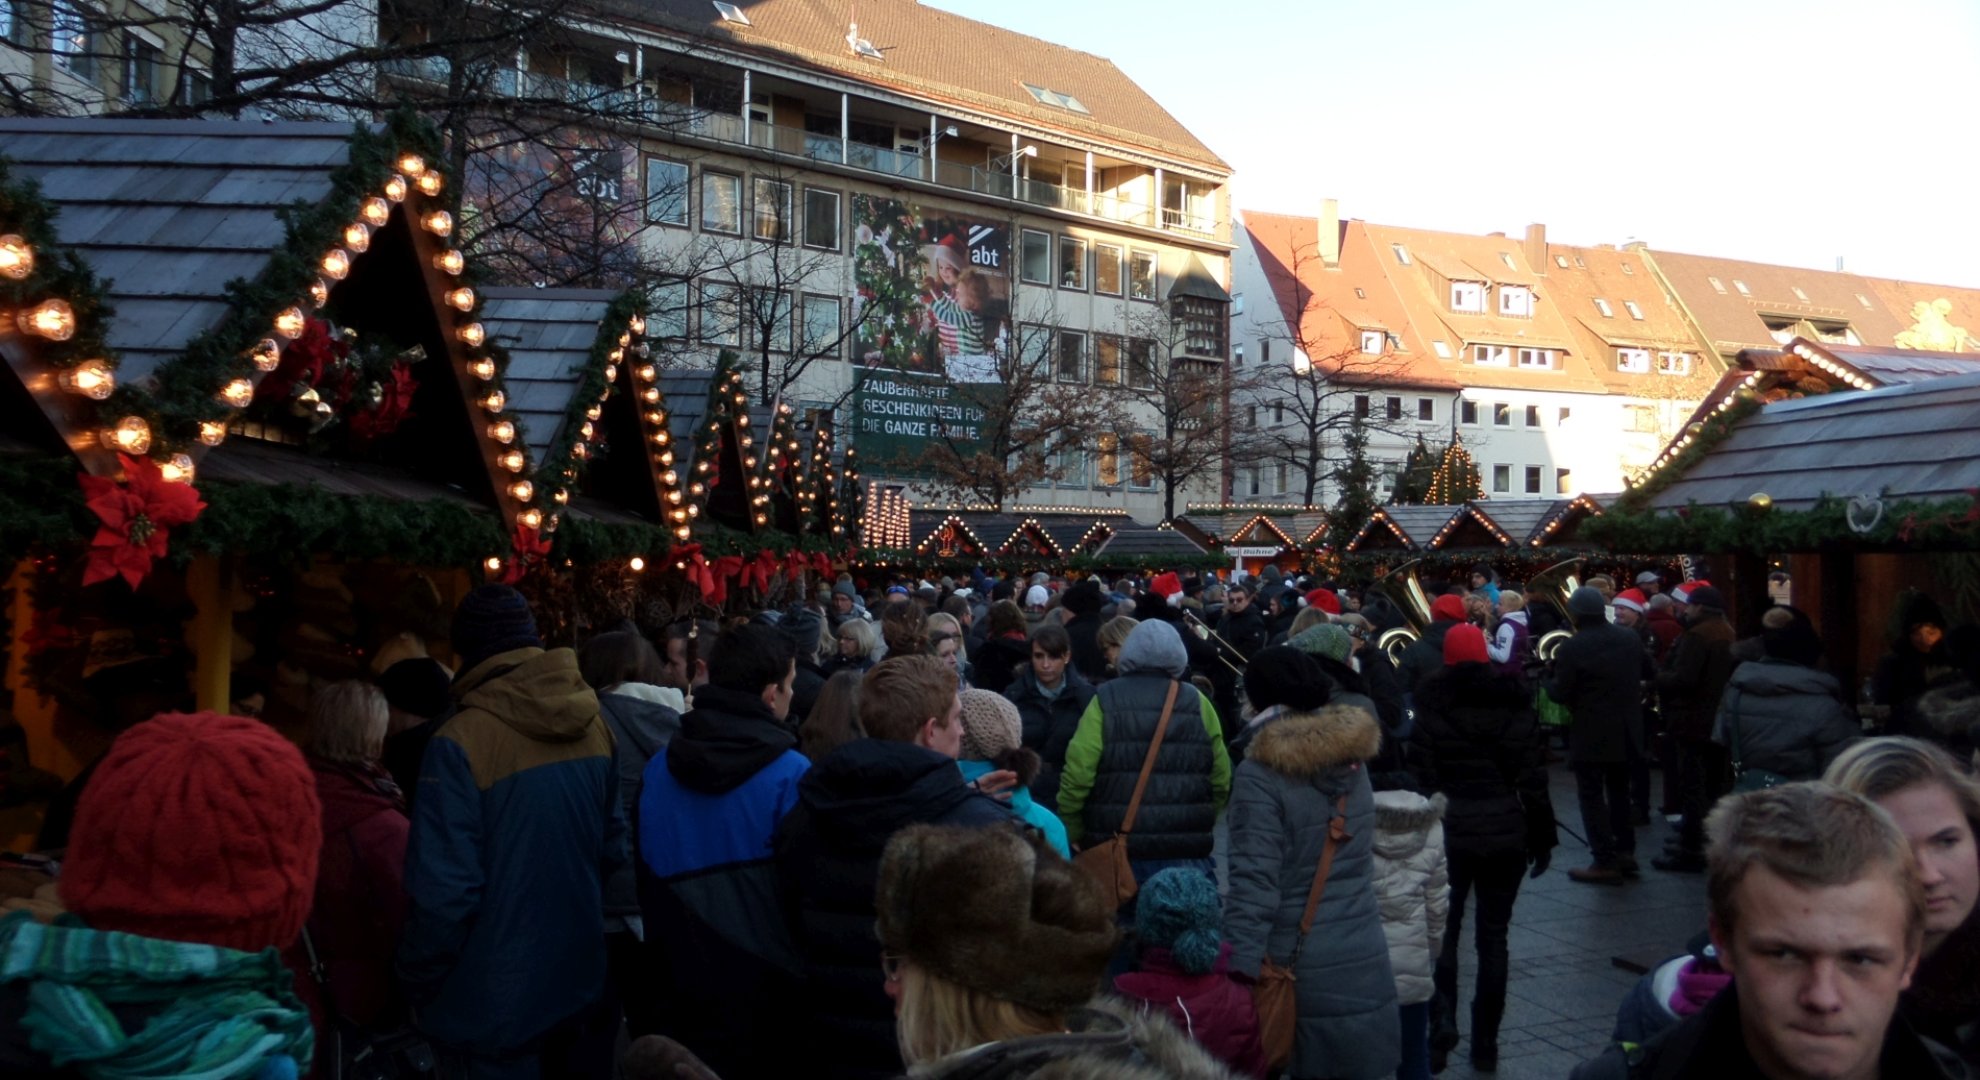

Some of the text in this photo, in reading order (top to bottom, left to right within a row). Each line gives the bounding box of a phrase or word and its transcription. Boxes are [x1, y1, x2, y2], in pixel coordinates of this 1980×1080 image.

[971, 245, 999, 267] abt
[862, 379, 949, 399] ZAUBERHAFTE
[862, 398, 962, 420] GESCHENKIDEEN
[862, 418, 880, 433] DIE
[884, 420, 927, 437] GANZE
